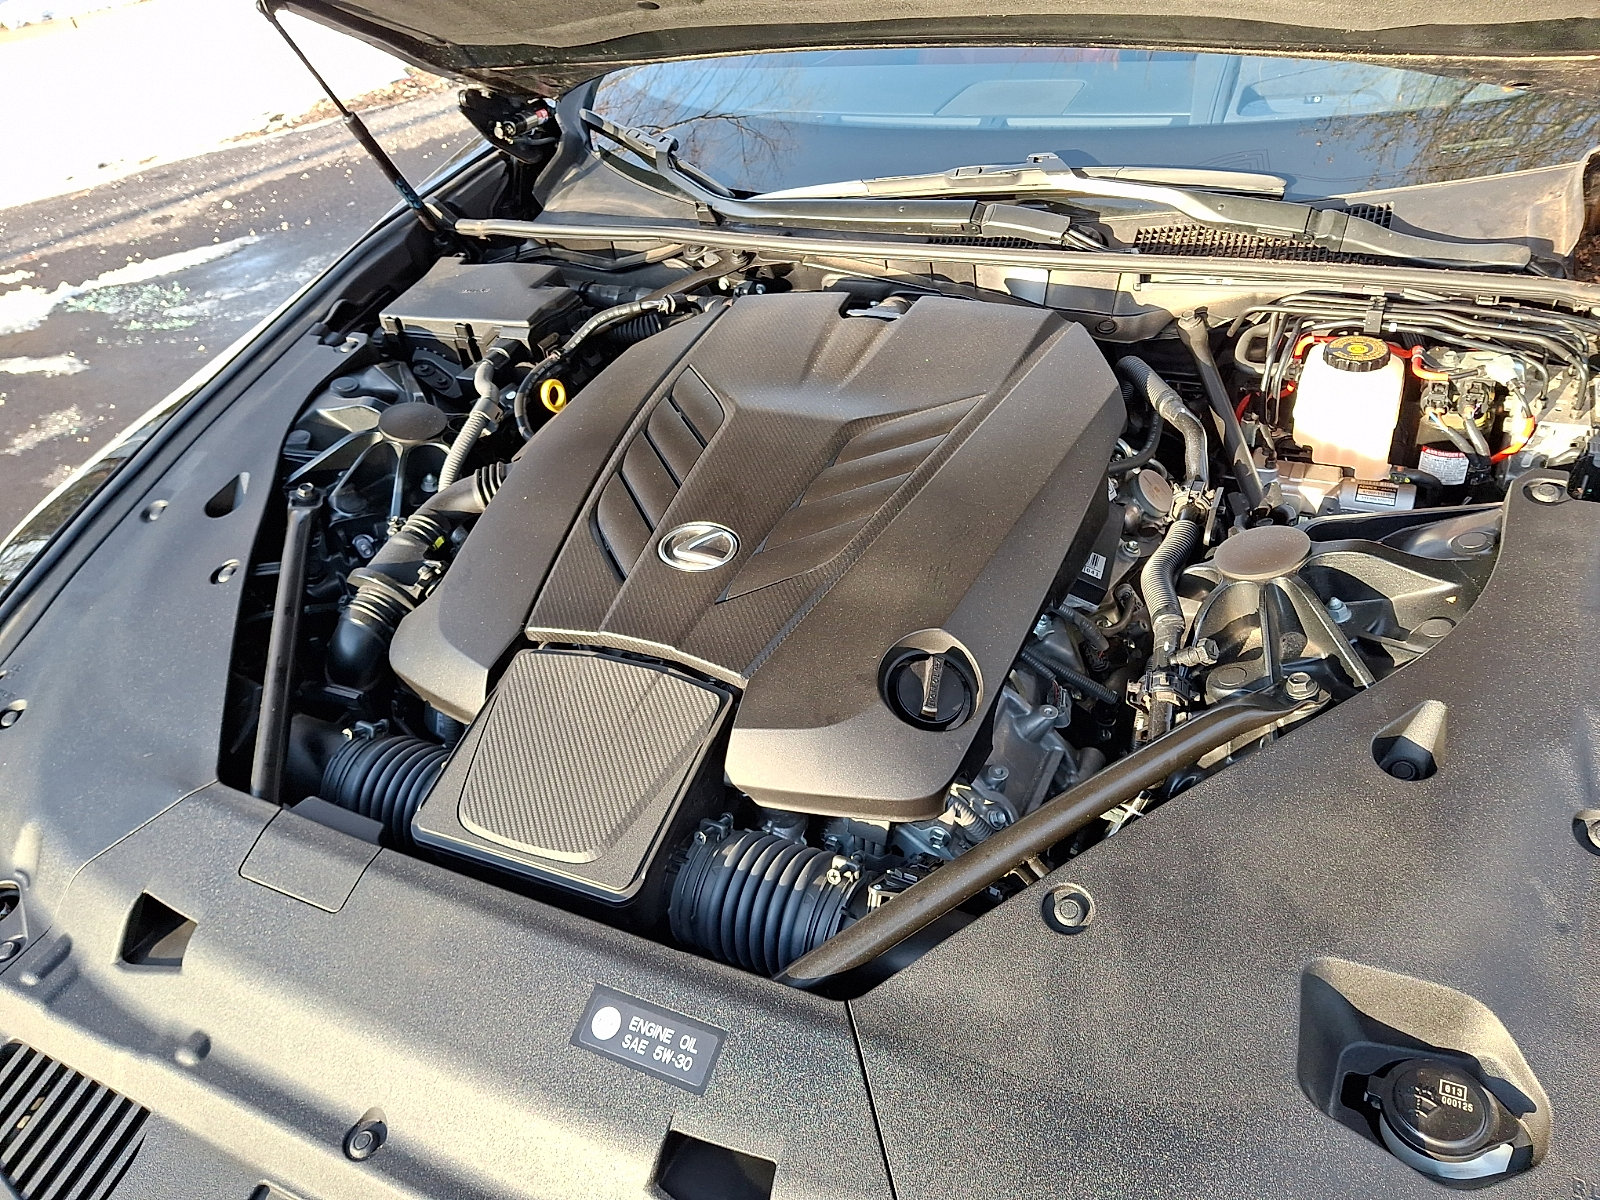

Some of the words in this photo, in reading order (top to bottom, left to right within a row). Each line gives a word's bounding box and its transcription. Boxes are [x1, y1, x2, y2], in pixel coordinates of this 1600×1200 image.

[621, 1034, 649, 1055] SAE
[653, 1045, 693, 1071] 5W-30
[629, 1016, 675, 1044] ENGINE
[679, 1035, 698, 1054] OIL
[1441, 1095, 1473, 1112] 000125
